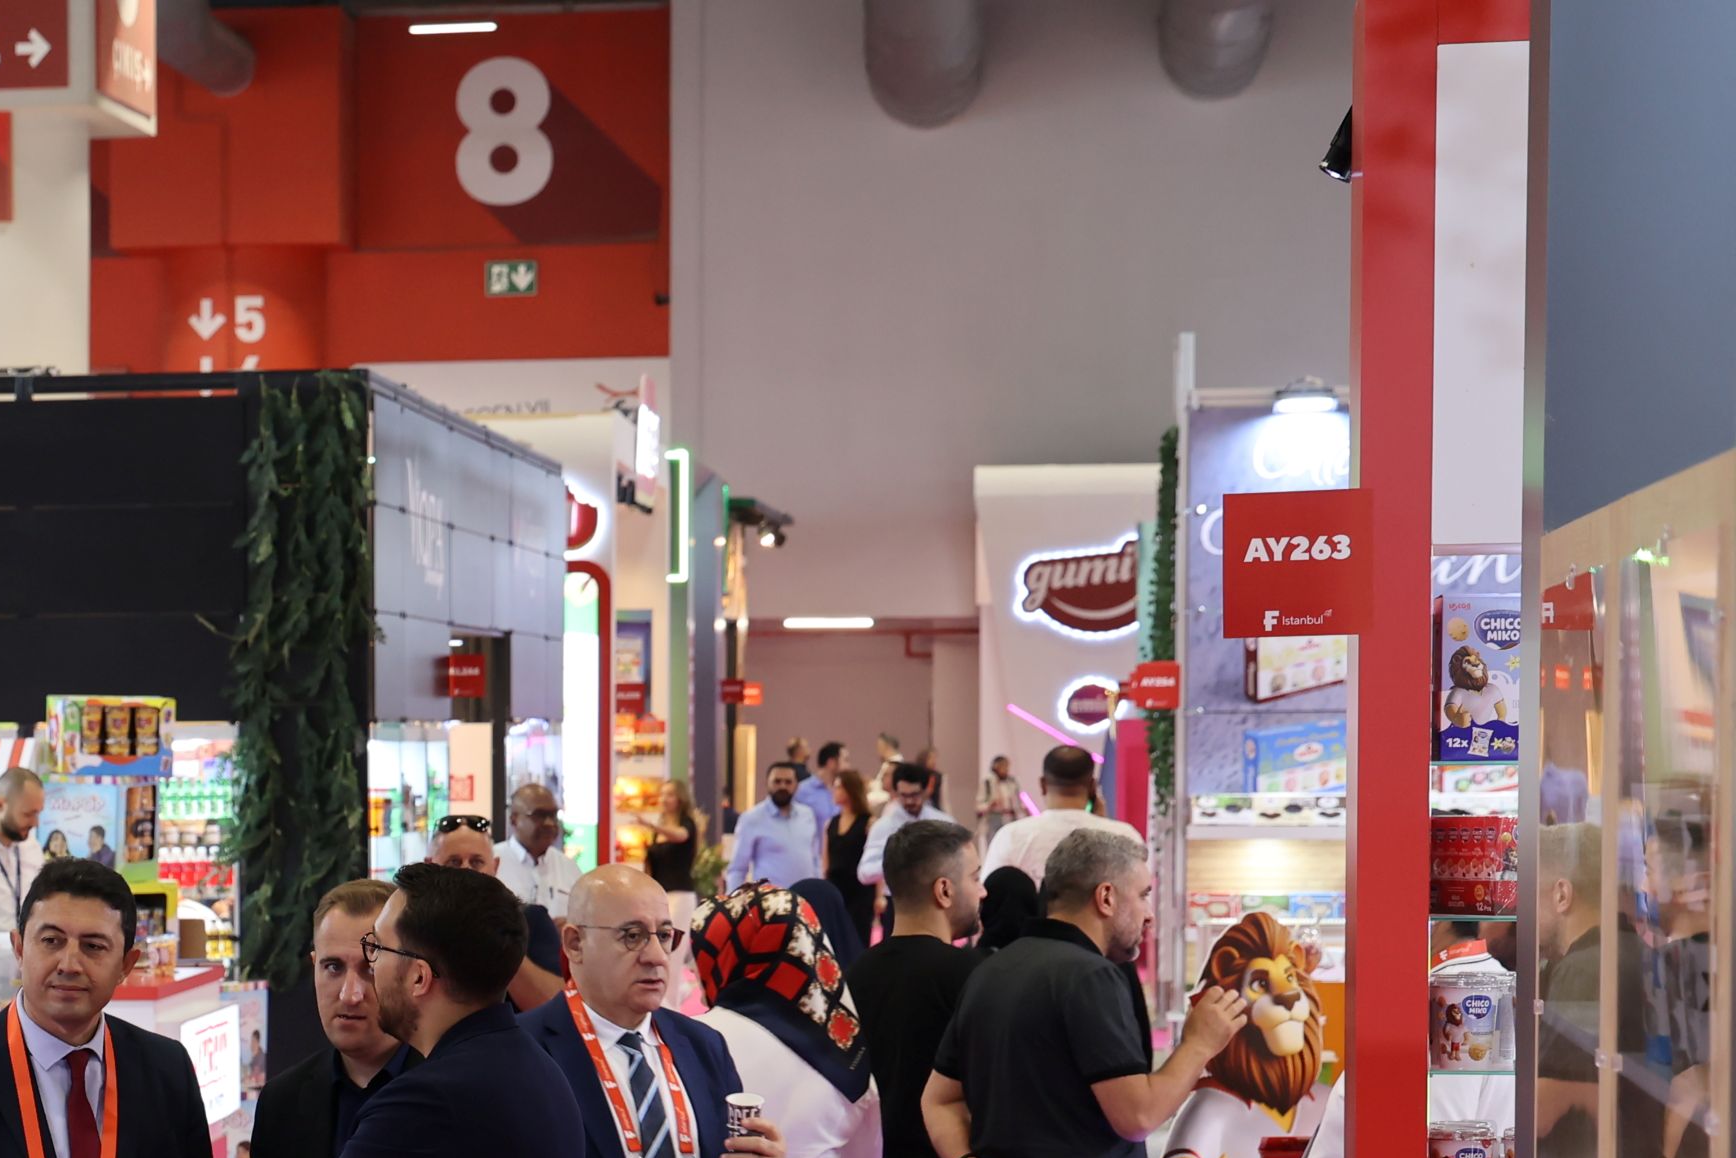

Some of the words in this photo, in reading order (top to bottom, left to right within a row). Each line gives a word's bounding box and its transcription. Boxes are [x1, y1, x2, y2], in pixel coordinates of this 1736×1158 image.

[456, 56, 554, 206] 8
[233, 294, 266, 344] 5
[1243, 534, 1351, 563] AY263
[1282, 614, 1324, 626] Istanbul
[1446, 737, 1469, 748] 12x
[1465, 999, 1490, 1008] CHICO
